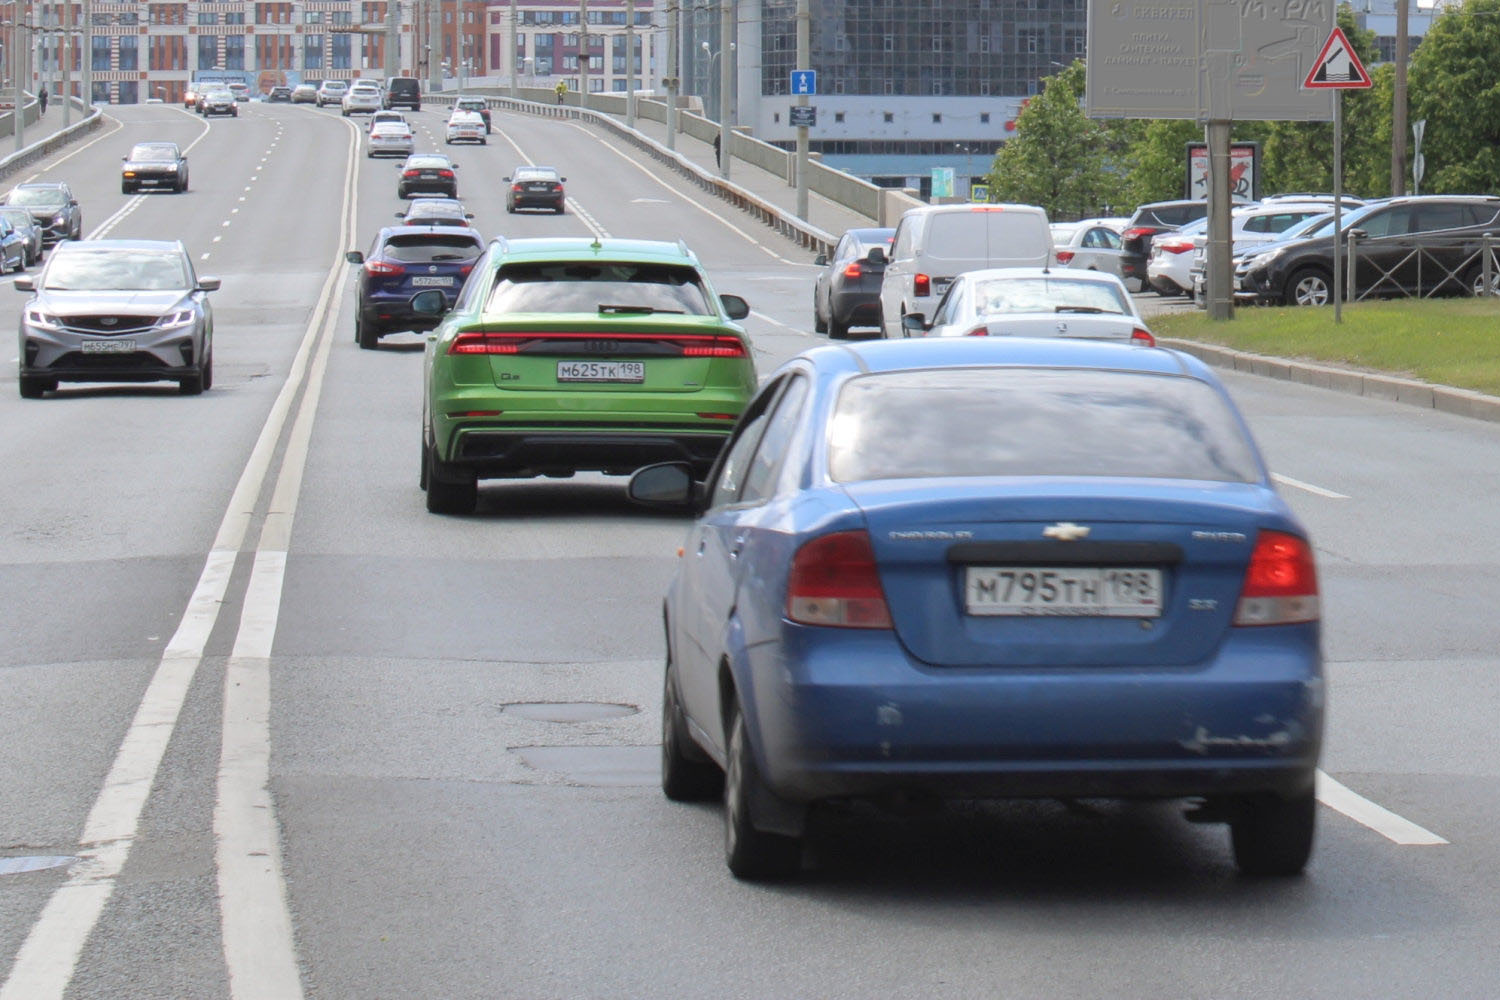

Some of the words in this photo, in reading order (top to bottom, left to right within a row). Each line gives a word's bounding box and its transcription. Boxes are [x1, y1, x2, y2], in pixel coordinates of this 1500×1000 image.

[561, 363, 617, 377] М625ТК
[620, 363, 641, 374] 198
[977, 572, 1097, 604] М795ТН
[1106, 572, 1150, 597] 198
